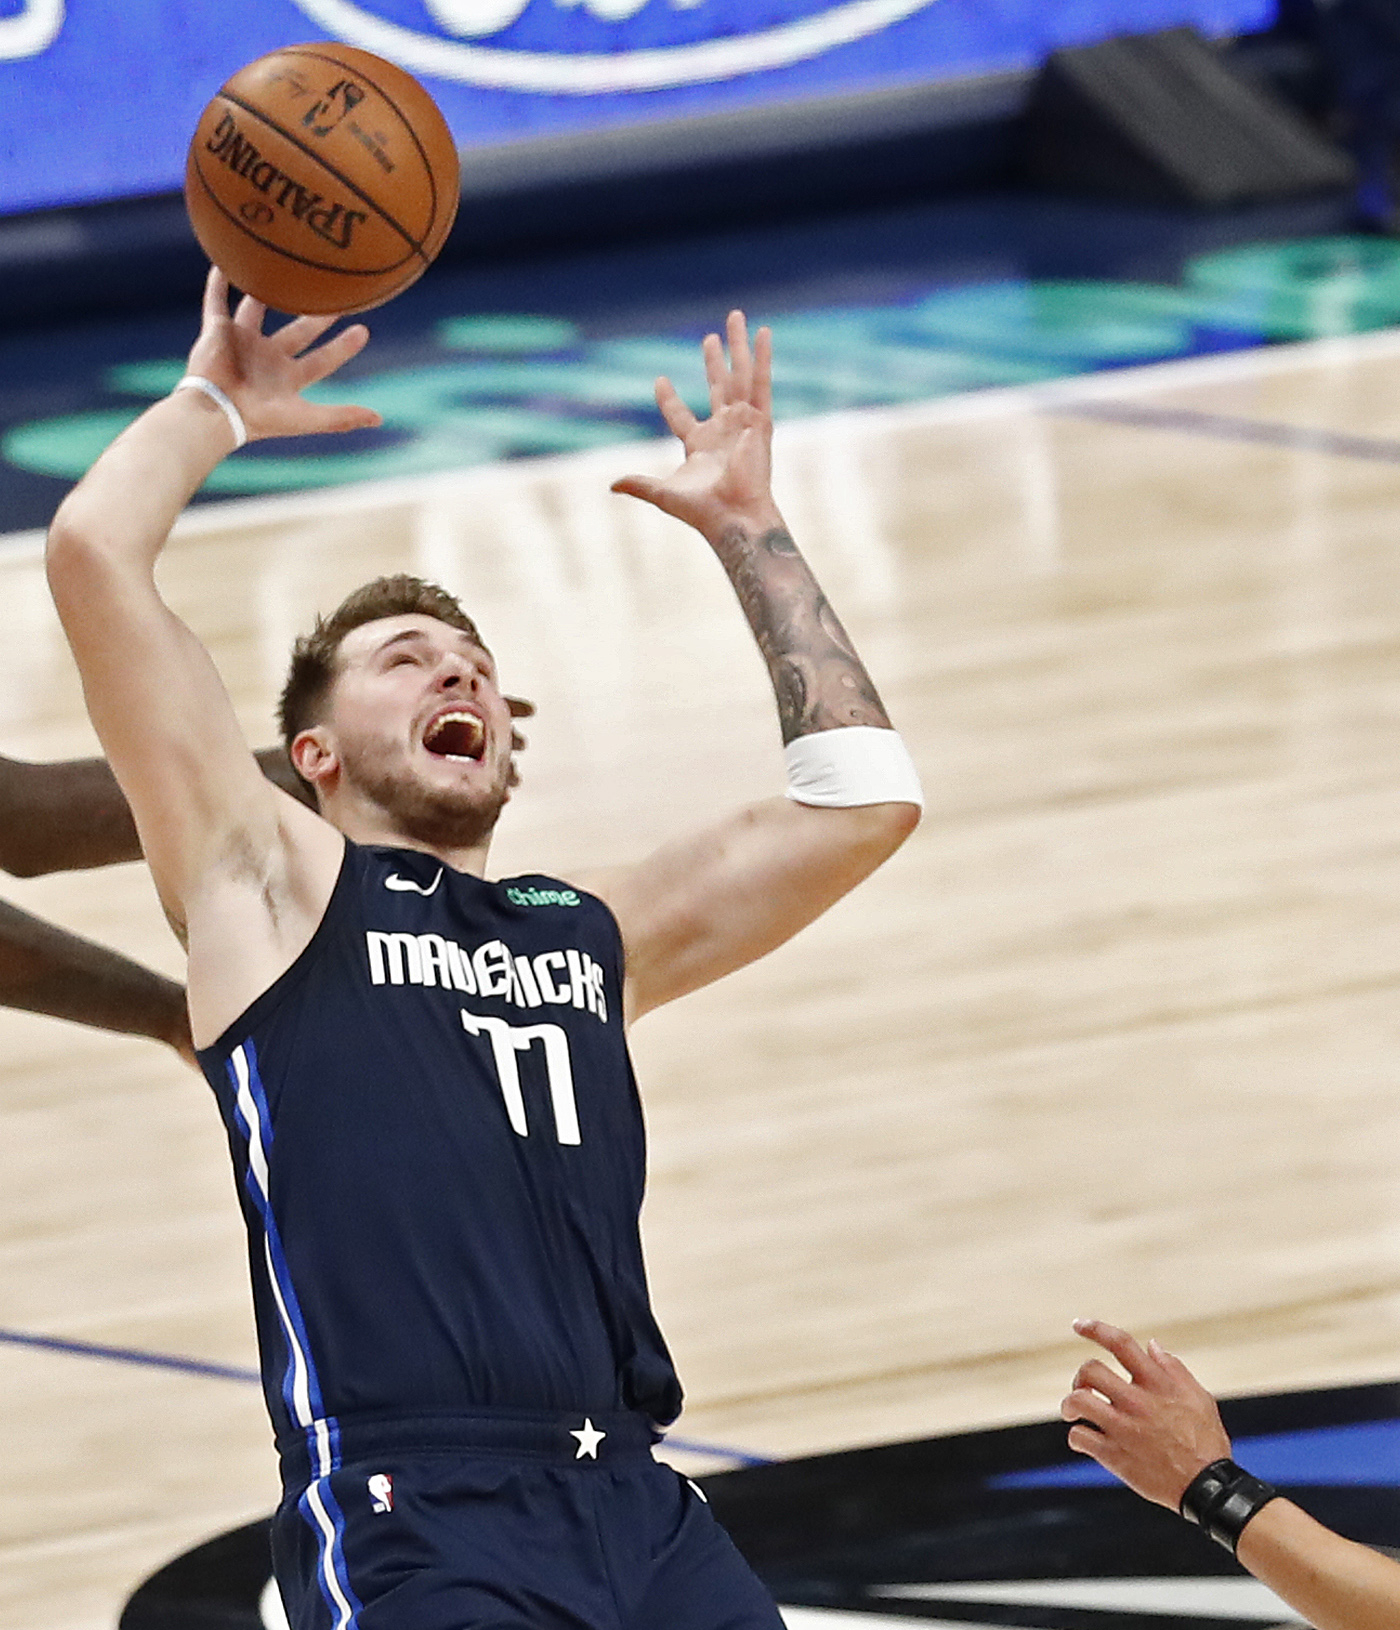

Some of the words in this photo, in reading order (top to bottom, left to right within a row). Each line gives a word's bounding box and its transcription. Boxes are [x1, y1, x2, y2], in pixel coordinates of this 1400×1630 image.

[205, 107, 368, 249] SPALDING
[366, 930, 608, 1024] MAVERICKS
[460, 1007, 582, 1146] 77
